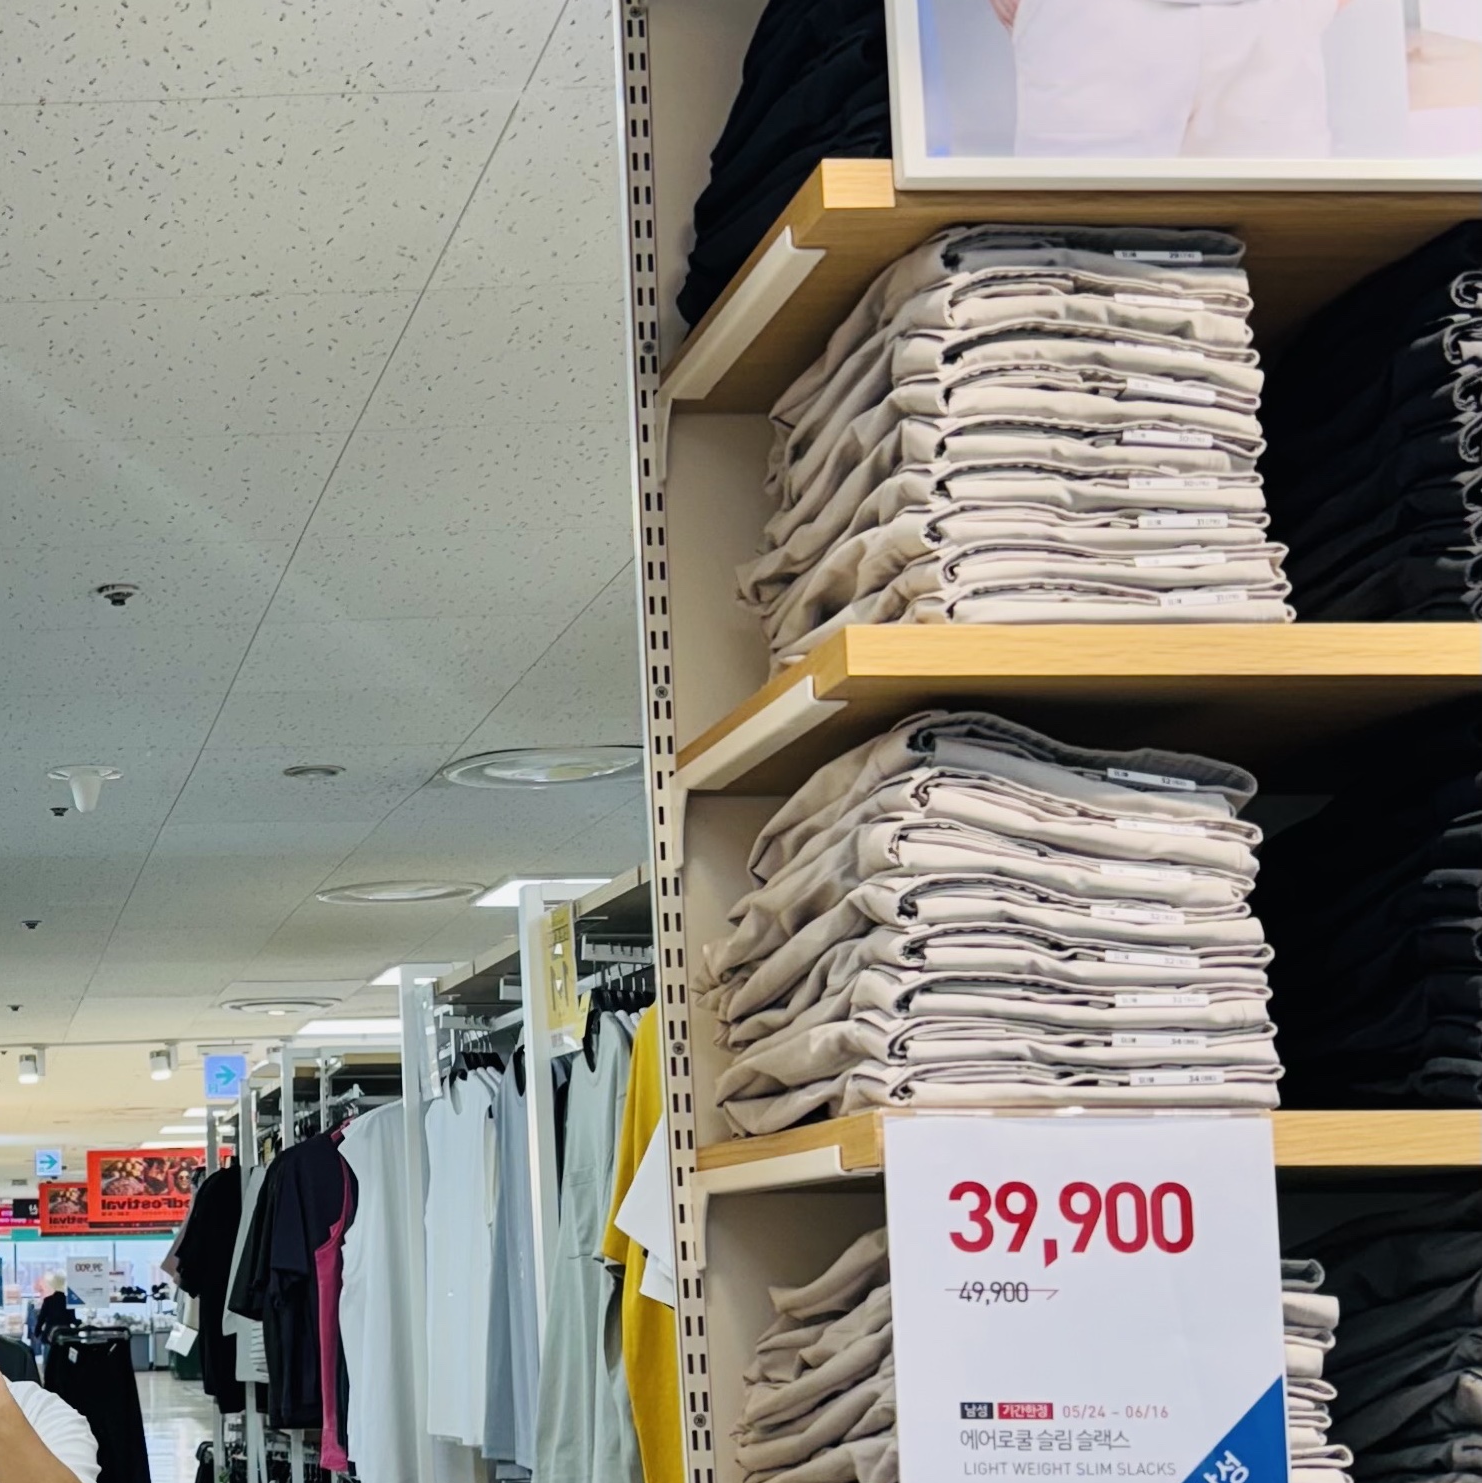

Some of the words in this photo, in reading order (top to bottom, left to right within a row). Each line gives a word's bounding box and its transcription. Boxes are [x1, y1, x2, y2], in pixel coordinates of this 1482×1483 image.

[948, 1181, 1195, 1269] 39,900
[958, 1281, 1029, 1305] 49,900
[964, 1404, 988, 1418] 남성
[1002, 1404, 1048, 1418] 기간한정
[1062, 1405, 1106, 1419] 05/24
[1125, 1405, 1168, 1419] 06/16
[960, 1429, 1032, 1451] 에어로쿨
[1037, 1429, 1072, 1451] 슬림
[1077, 1429, 1131, 1451] 슬랙스
[964, 1462, 1007, 1476] LIGHT
[1012, 1462, 1071, 1476] WEIGHT
[1076, 1462, 1112, 1476] SLIM
[1117, 1462, 1176, 1476] SLACKS
